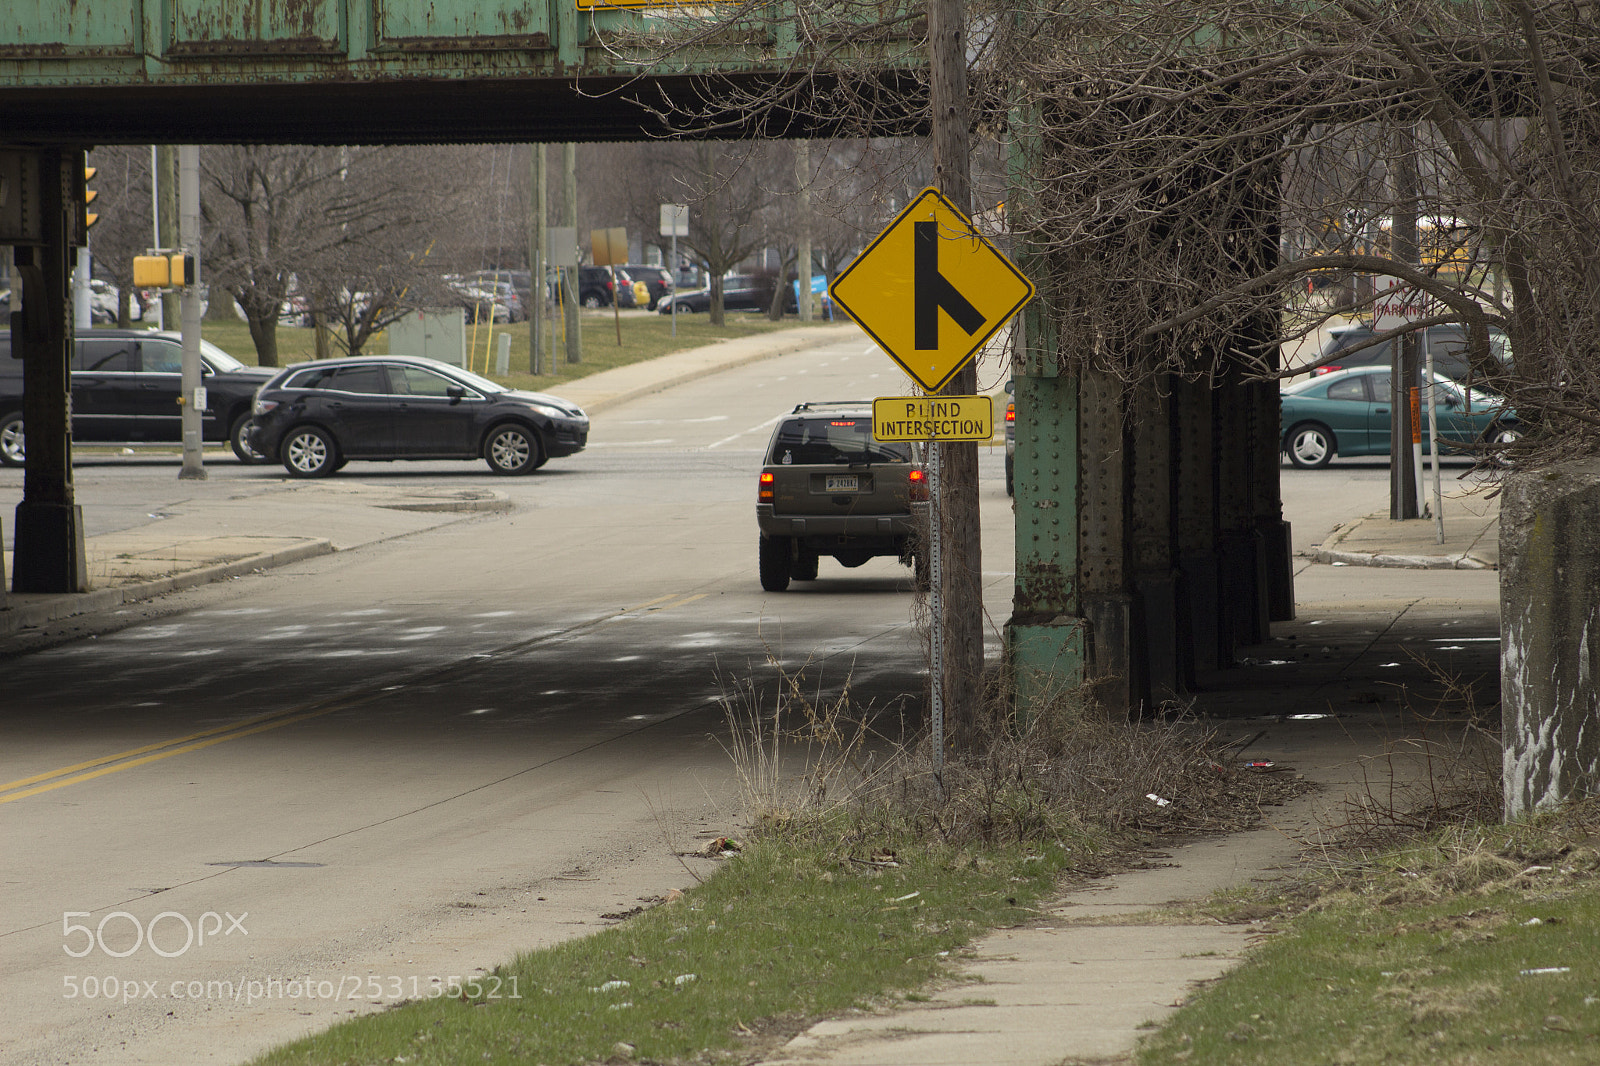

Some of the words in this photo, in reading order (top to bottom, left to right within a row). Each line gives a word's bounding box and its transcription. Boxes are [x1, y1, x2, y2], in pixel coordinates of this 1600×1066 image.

[1377, 303, 1425, 316] PARIN
[906, 402, 960, 418] BLIND
[881, 420, 983, 436] INTERSECTION
